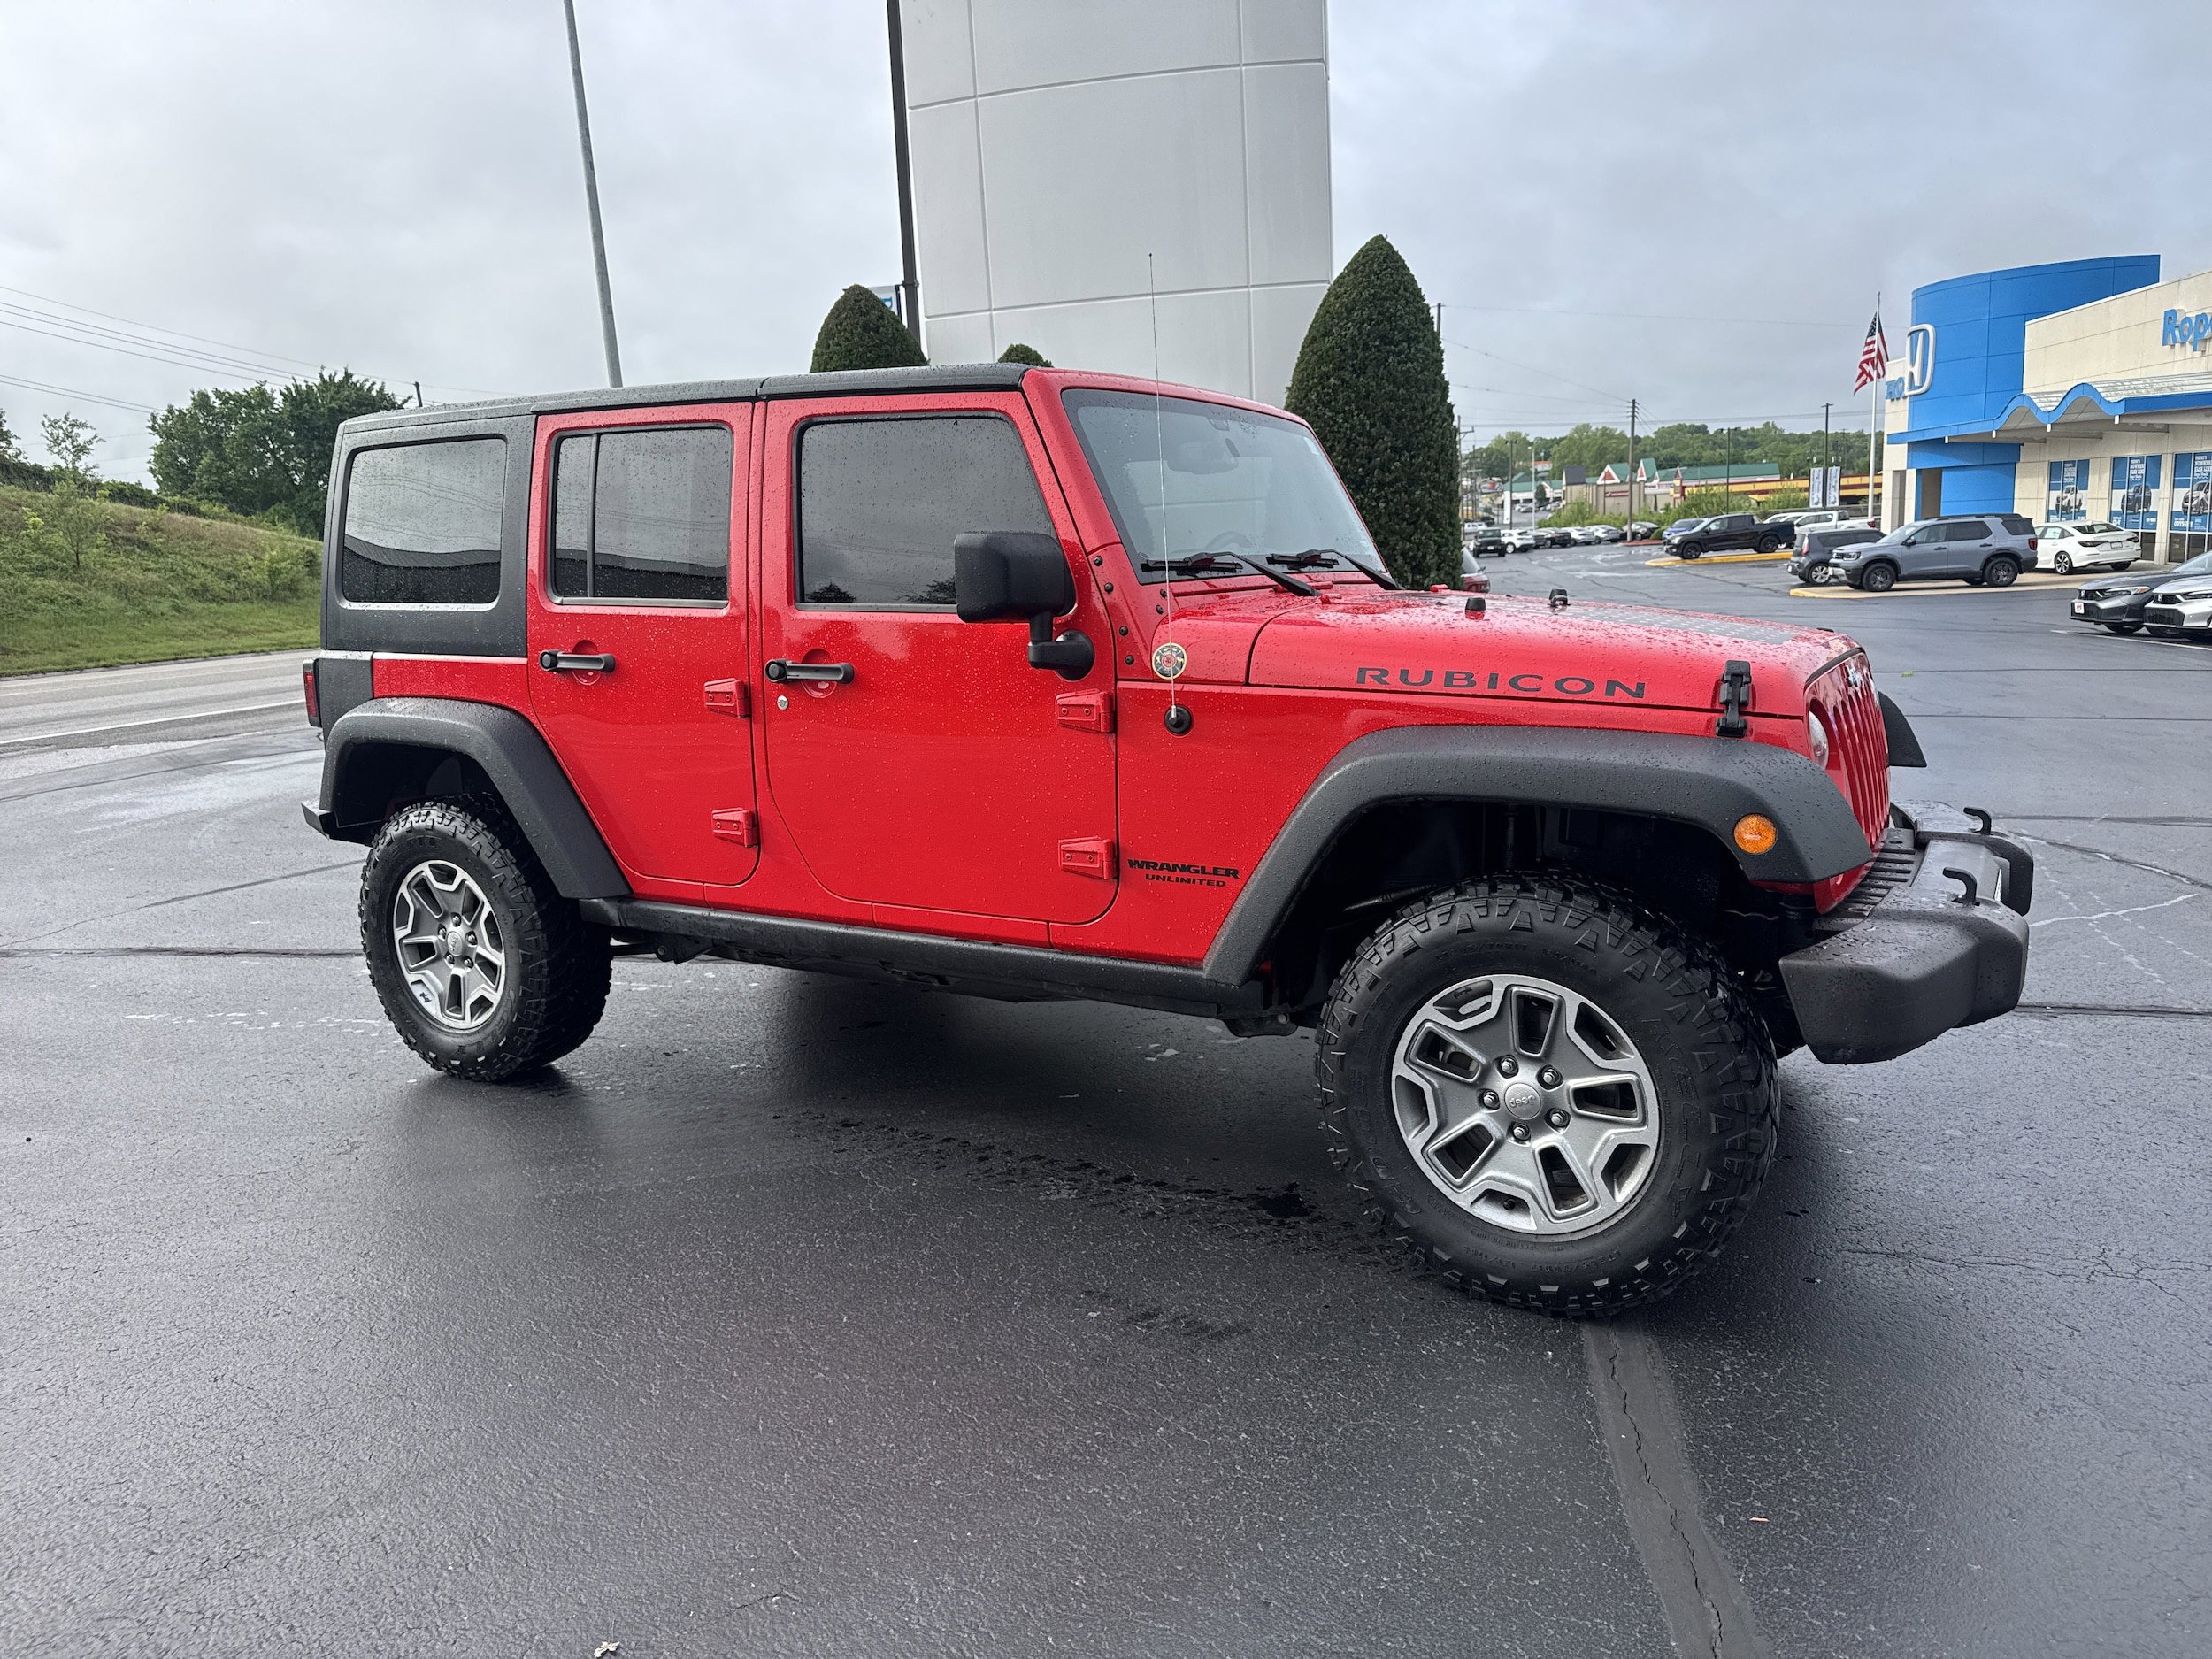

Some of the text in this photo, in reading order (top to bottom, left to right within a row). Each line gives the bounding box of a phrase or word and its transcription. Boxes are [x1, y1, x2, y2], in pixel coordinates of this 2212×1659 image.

[2162, 308, 2212, 352] Rop
[1356, 666, 1647, 699] RUBICON
[1127, 858, 1240, 879] WRANGLER
[1145, 873, 1227, 887] UNLIMITED
[1509, 1094, 1537, 1109] Jeep
